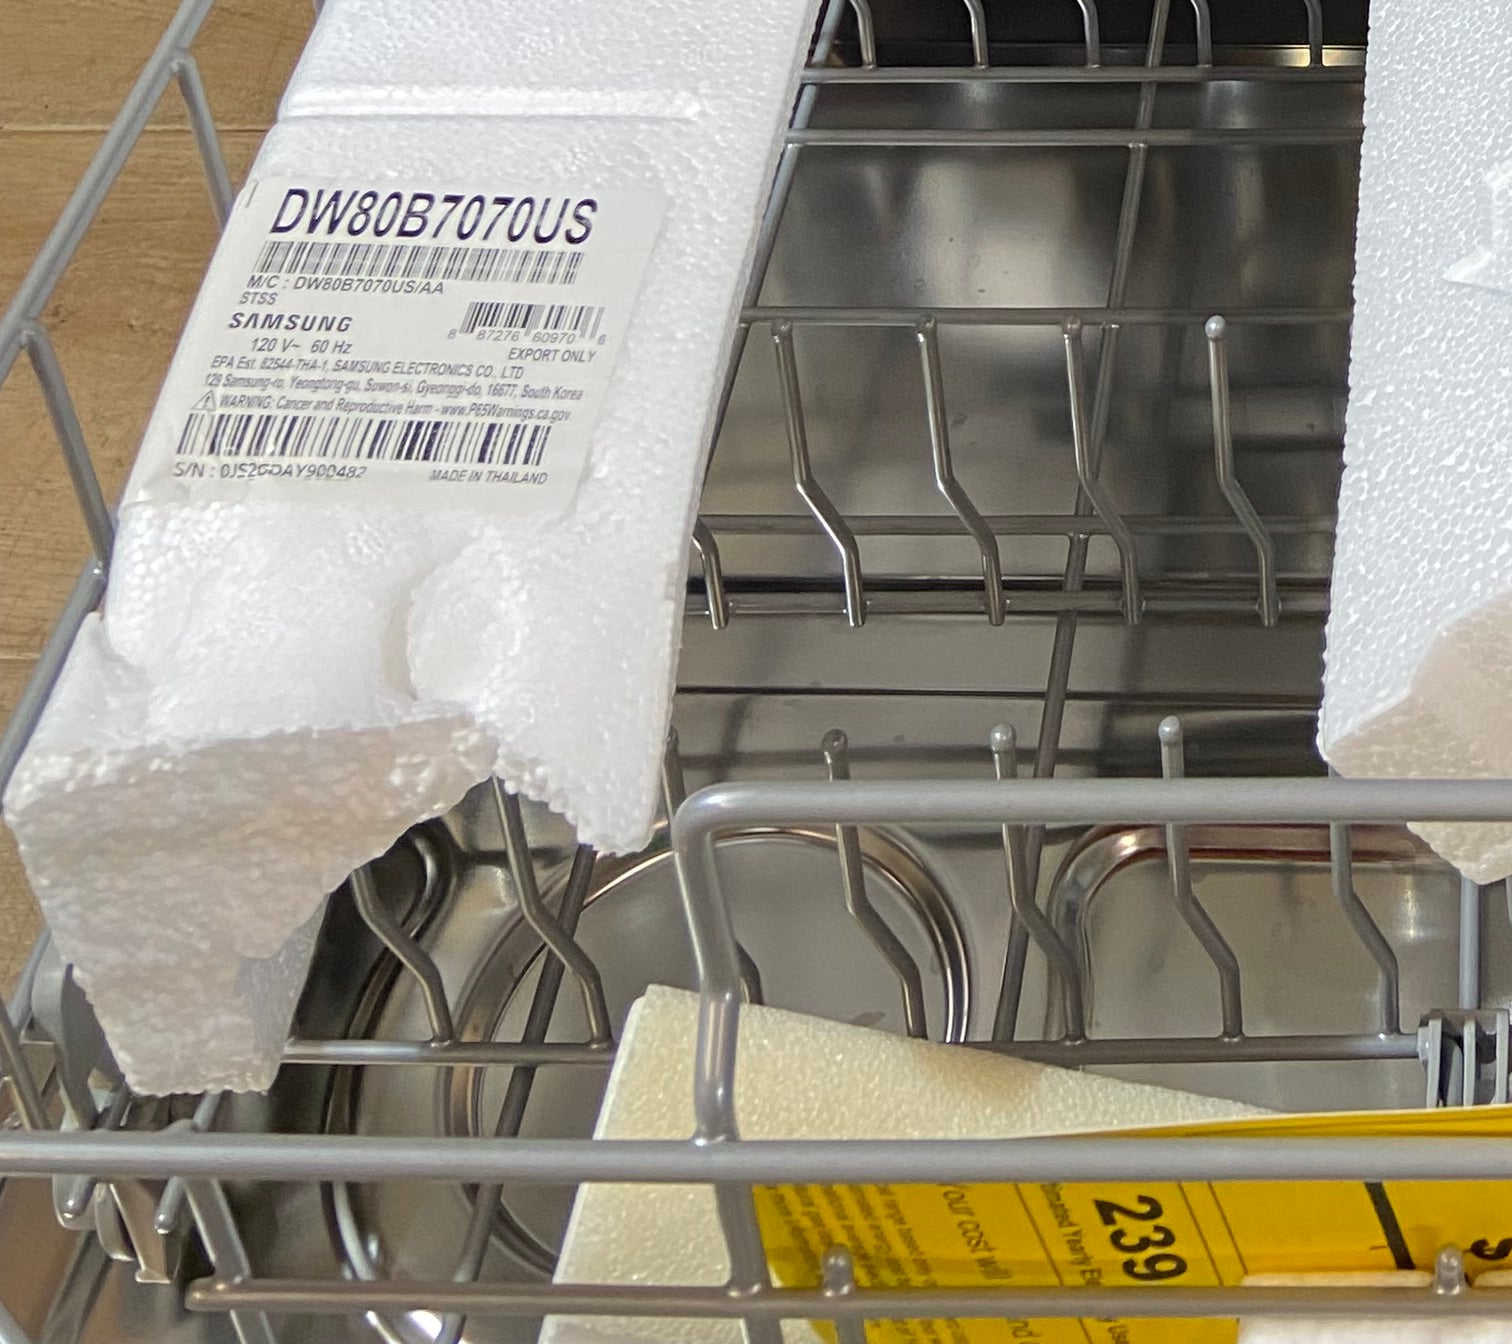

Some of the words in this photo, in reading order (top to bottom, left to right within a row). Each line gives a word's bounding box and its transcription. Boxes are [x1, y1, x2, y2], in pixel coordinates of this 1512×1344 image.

[269, 188, 598, 245] DW80B7070US
[247, 274, 280, 290] M/C
[293, 277, 445, 295] DW80B7070US/AA
[239, 291, 278, 305] STSS
[228, 312, 353, 333] SAMSUNG
[250, 337, 277, 353] 120
[310, 339, 329, 354] 60
[332, 340, 353, 354] Hz
[508, 347, 560, 362] EXPORT
[561, 350, 597, 363] ONLY
[210, 355, 234, 369] EPA
[332, 359, 390, 374] SAMSUNG
[392, 361, 473, 377] ELECTRONICS
[501, 366, 524, 379] LTD
[520, 384, 550, 399] South
[551, 386, 583, 400] Korea
[276, 395, 312, 410] Cancer
[314, 397, 334, 411] and
[337, 397, 402, 415] Reproductive
[405, 401, 433, 415] Harm
[173, 462, 204, 478] S/N
[429, 469, 468, 483] MADE
[468, 470, 482, 483] IN
[485, 470, 549, 486] THAILAND
[957, 1218, 997, 1254] cost
[1092, 1194, 1188, 1282] 239
